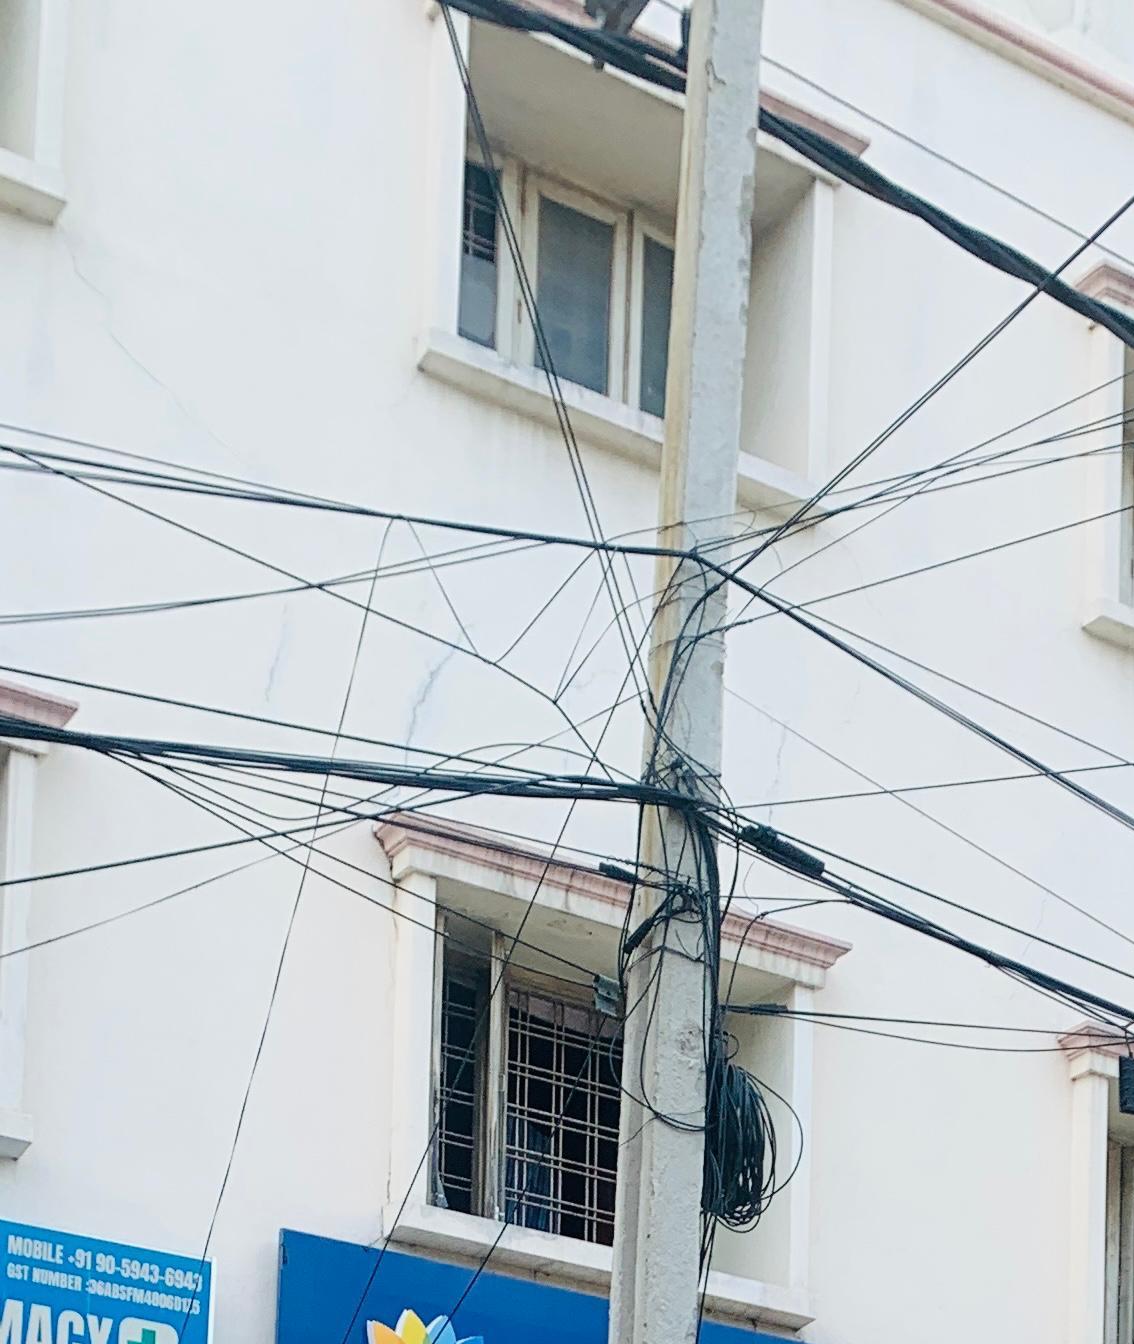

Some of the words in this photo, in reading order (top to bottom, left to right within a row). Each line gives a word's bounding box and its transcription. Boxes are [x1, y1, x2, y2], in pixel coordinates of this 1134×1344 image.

[7, 1263, 29, 1280] GST
[32, 1267, 82, 1291] NUMBER
[8, 1235, 64, 1264] MOBILE
[68, 1249, 91, 1270] +91
[96, 1252, 202, 1292] 90-5943-6943
